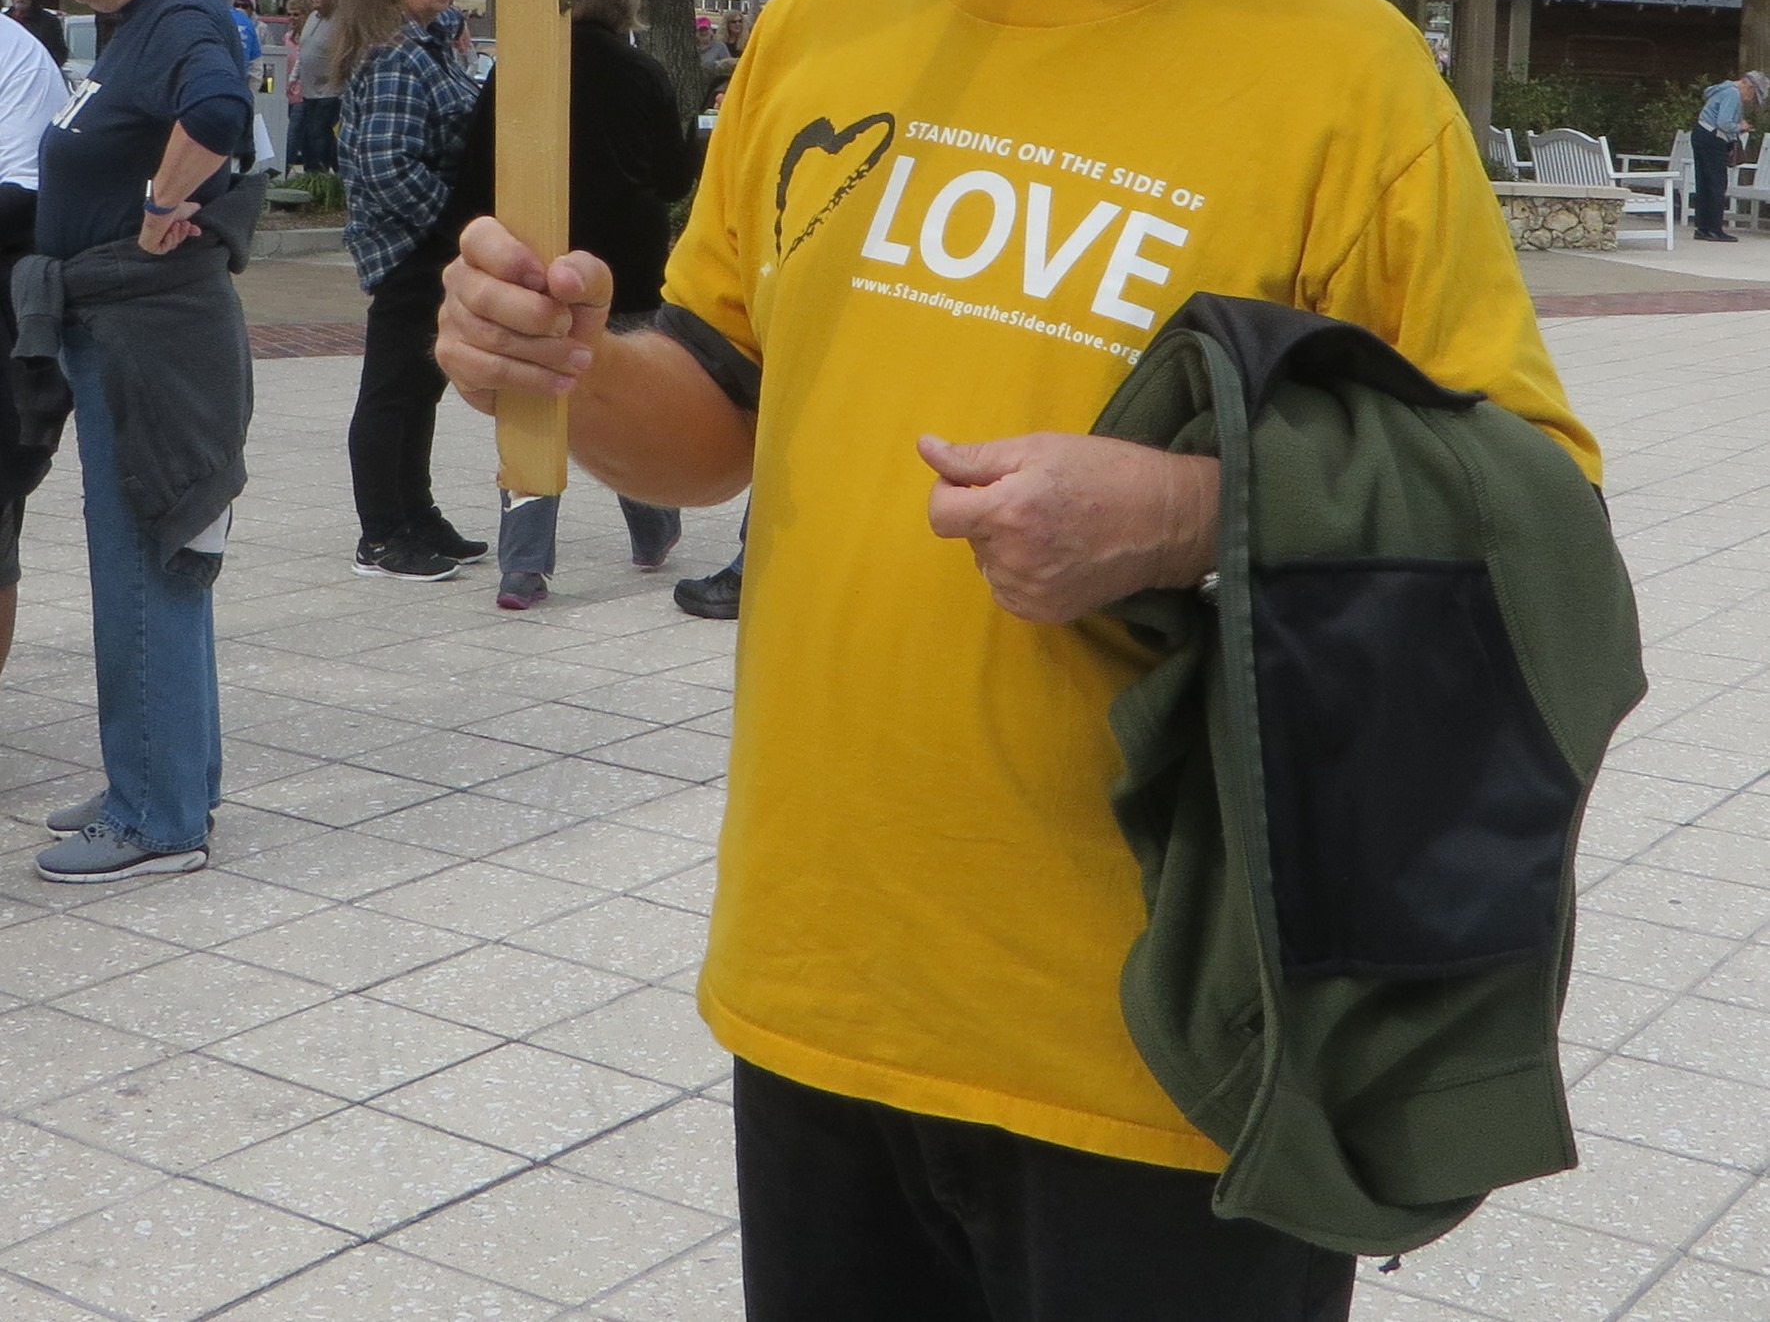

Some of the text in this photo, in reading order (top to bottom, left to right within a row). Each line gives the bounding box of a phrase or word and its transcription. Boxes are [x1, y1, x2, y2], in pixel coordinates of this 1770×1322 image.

[905, 120, 1206, 212] STANDING ON THE SIDE OF
[860, 154, 1190, 331] LOVE
[850, 275, 1142, 366] www.StandingontheSideofLove.org
